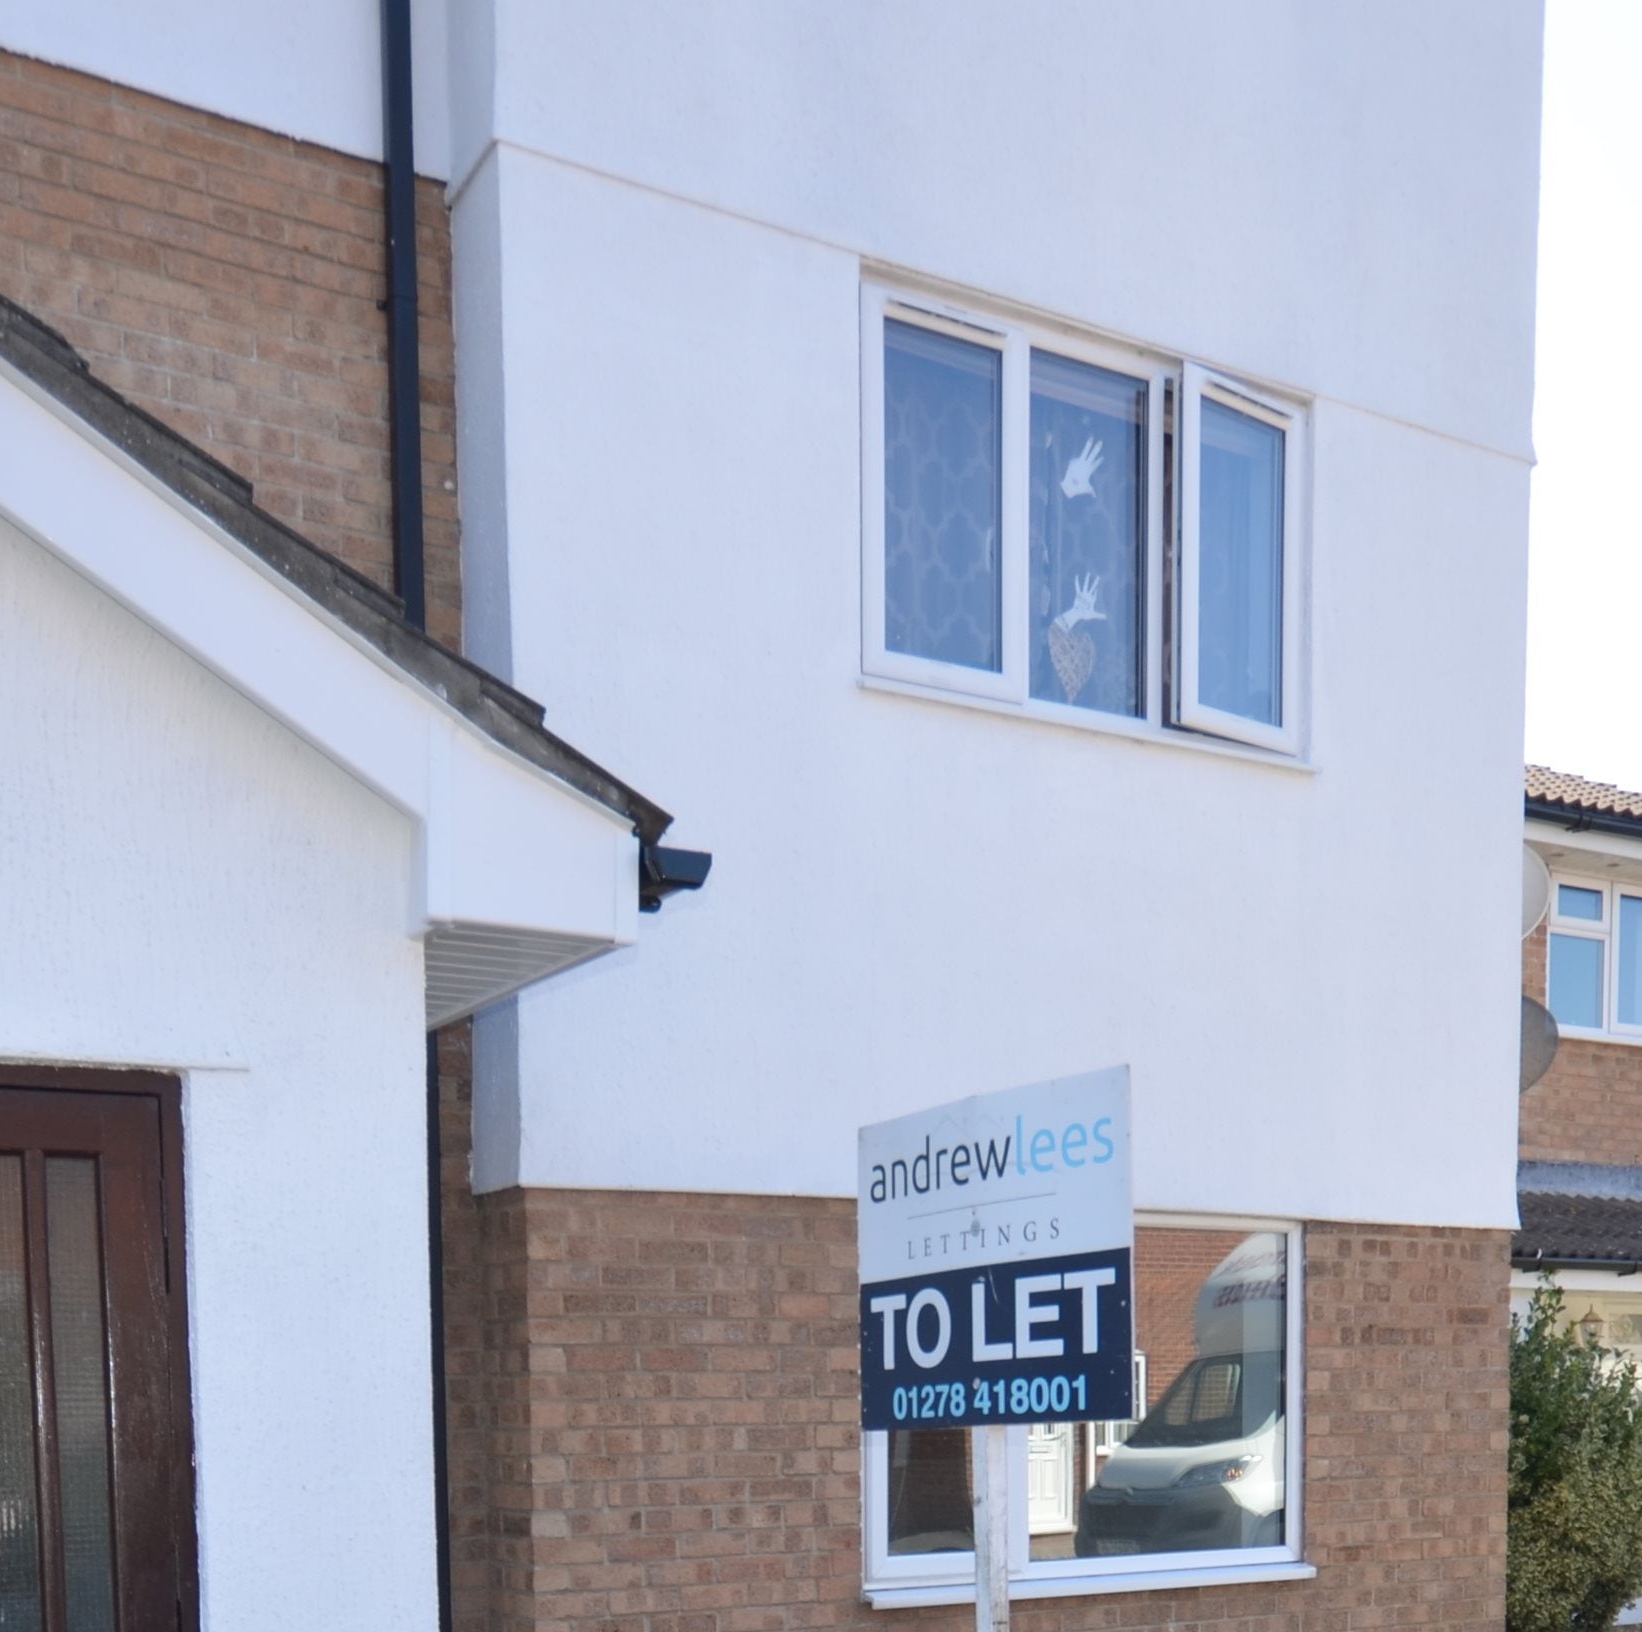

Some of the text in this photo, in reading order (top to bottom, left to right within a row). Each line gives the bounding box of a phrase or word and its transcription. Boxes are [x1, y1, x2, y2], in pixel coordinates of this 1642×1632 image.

[870, 1114, 1115, 1204] andrewlees
[907, 1218, 1061, 1260] LETTINGS
[870, 1267, 1117, 1370] TO LET
[893, 1374, 1087, 1420] 01278 418001
